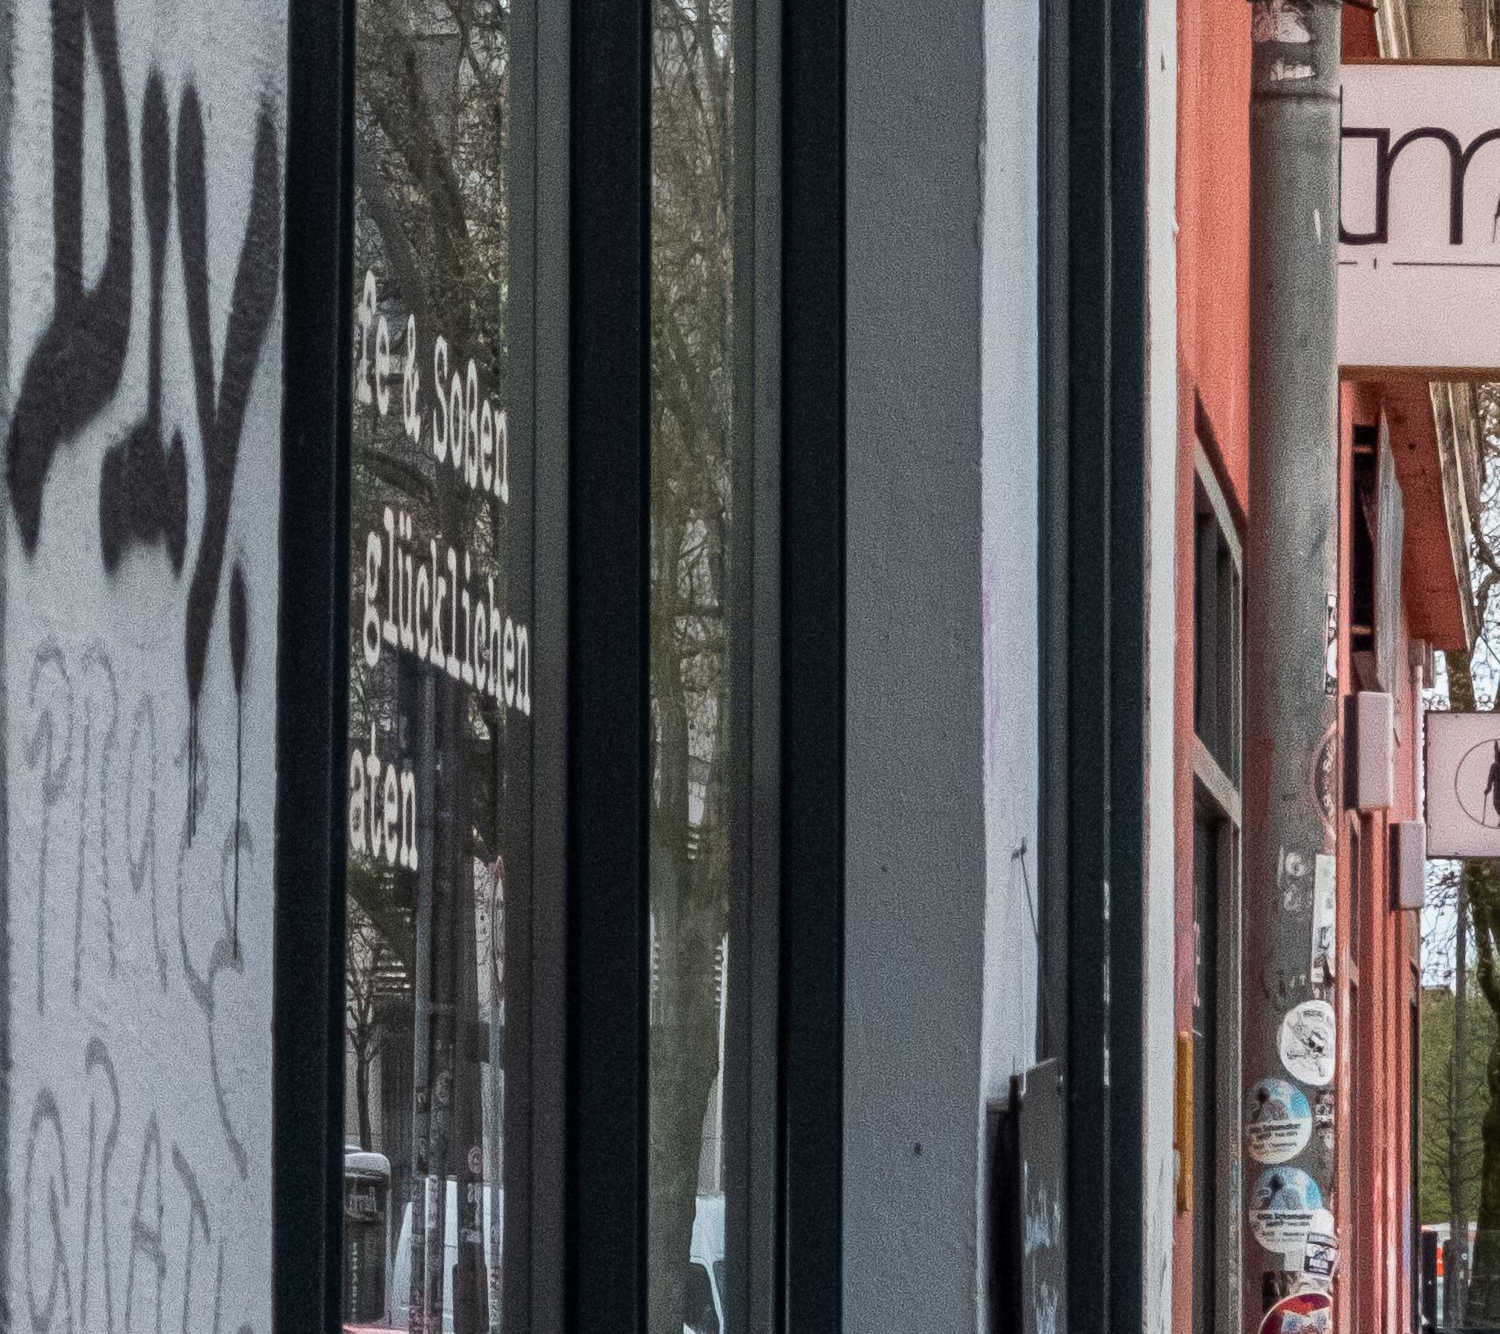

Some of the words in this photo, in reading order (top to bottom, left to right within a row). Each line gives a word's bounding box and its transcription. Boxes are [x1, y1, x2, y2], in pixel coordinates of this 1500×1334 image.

[401, 311, 421, 445] &
[432, 333, 509, 504] Soßen
[361, 505, 531, 717] glücklichen
[348, 722, 419, 871] aten
